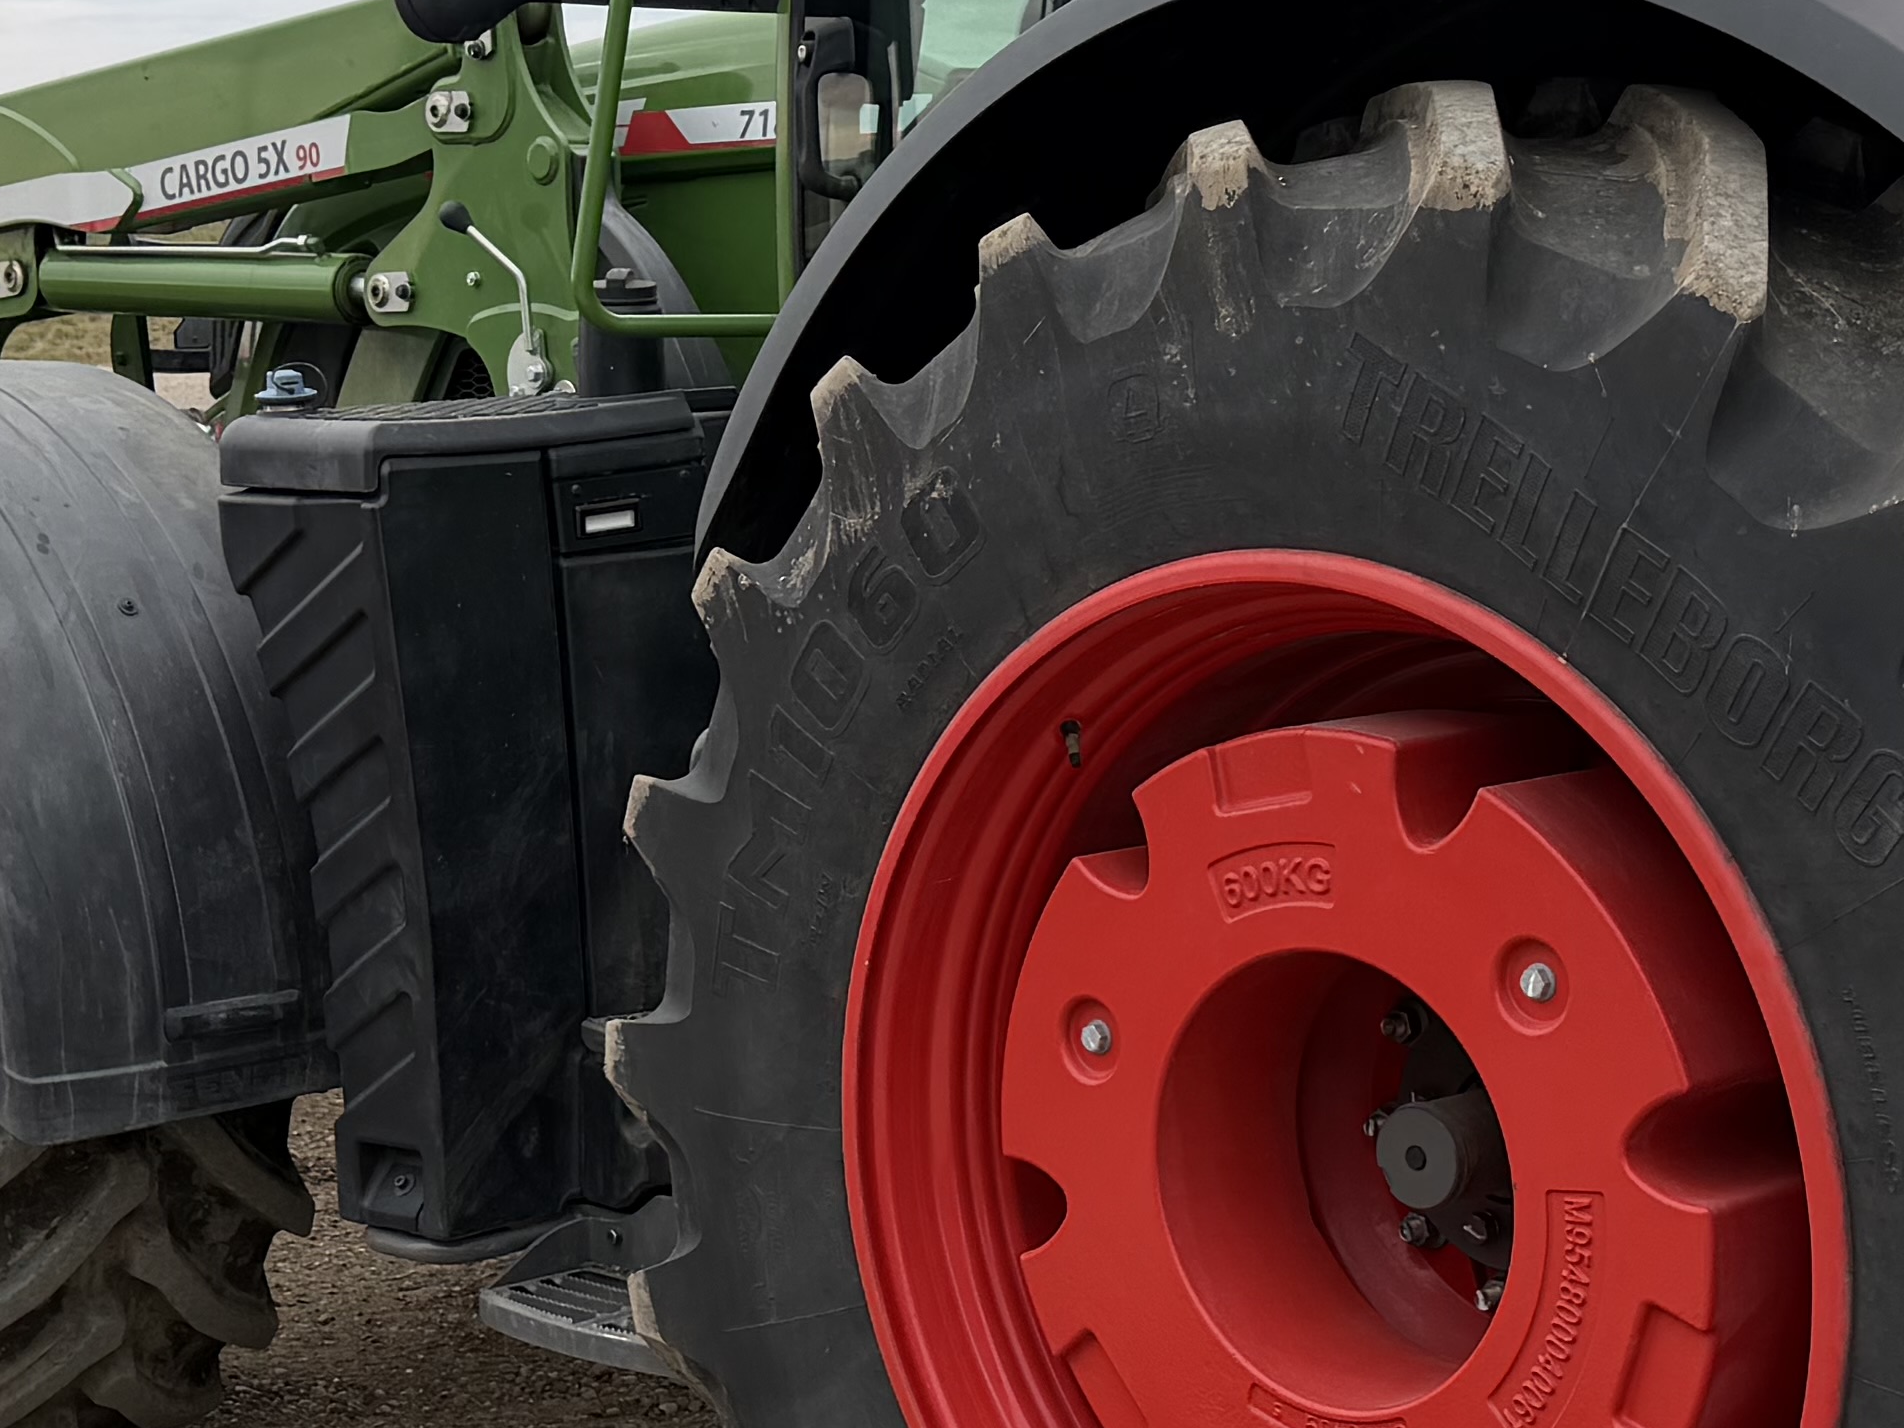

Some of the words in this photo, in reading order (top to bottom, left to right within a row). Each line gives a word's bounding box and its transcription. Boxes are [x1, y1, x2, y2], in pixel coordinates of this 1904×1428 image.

[739, 108, 777, 139] 71
[158, 149, 250, 202] CARGO
[256, 139, 289, 180] 5X
[295, 141, 321, 171] 90
[712, 465, 987, 998] TM1060
[1222, 857, 1332, 908] 600KG
